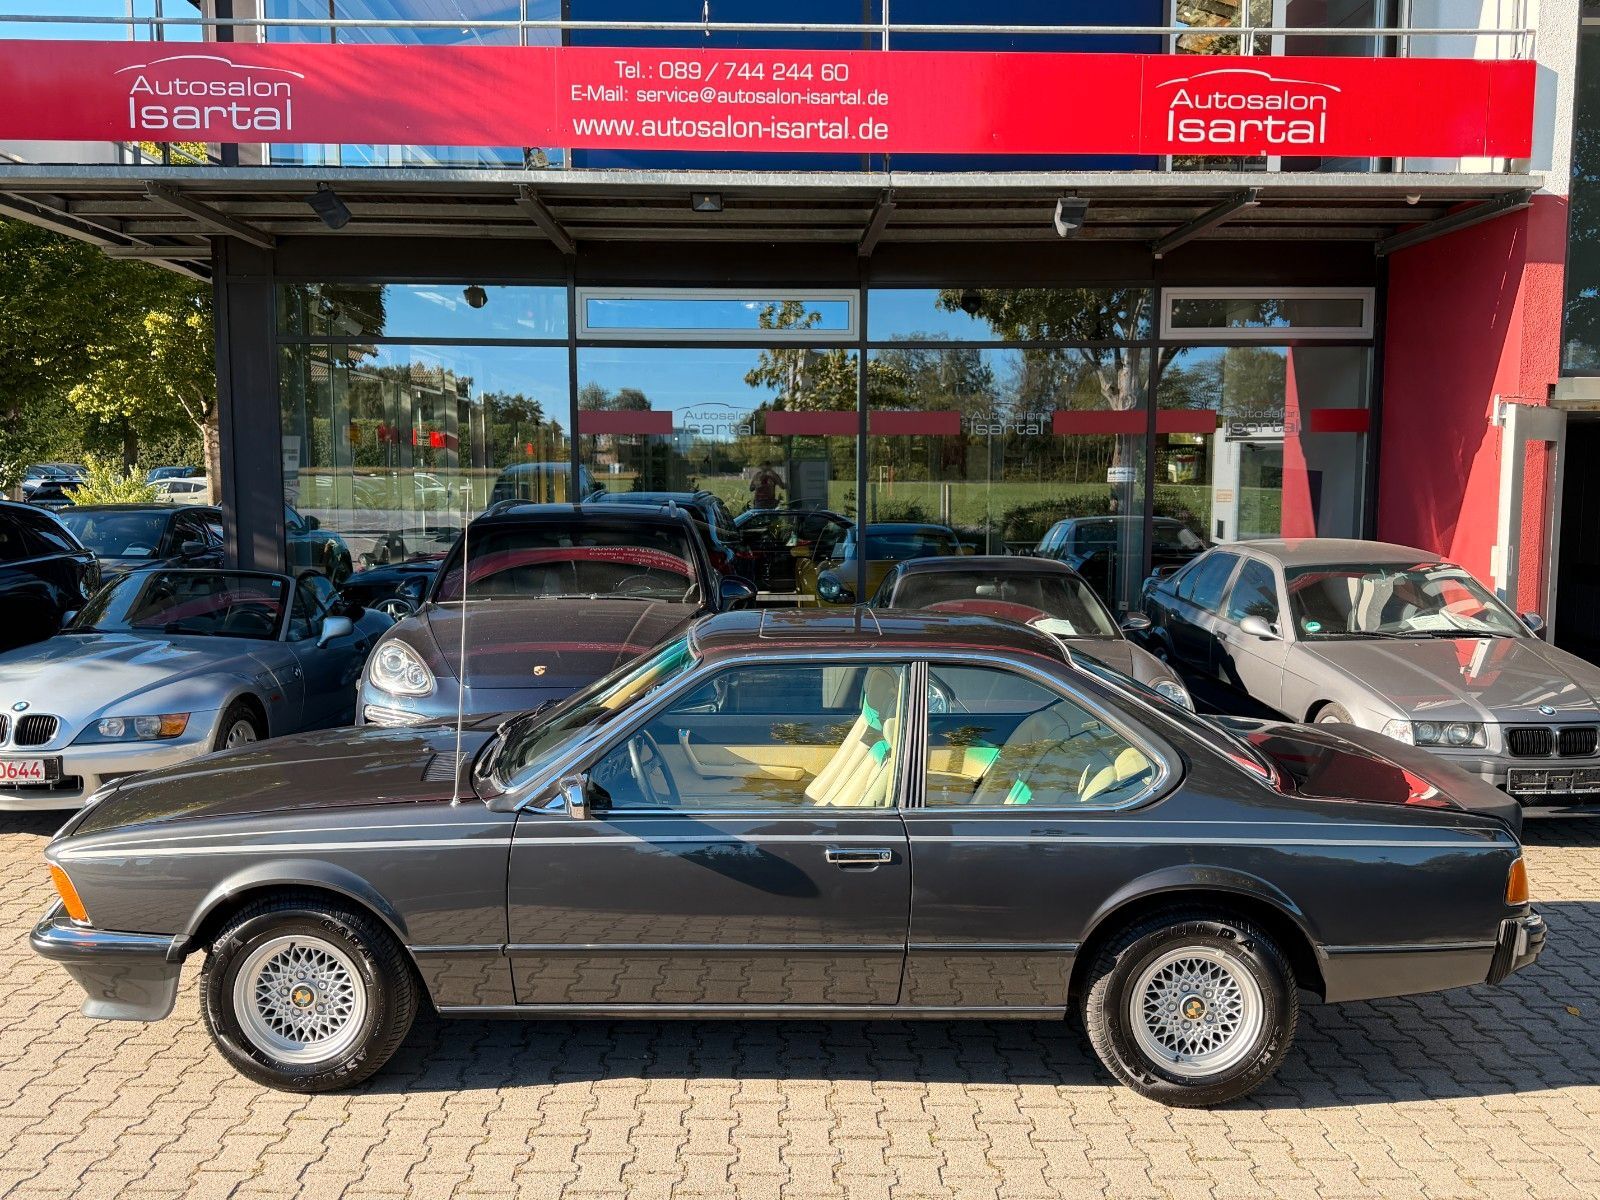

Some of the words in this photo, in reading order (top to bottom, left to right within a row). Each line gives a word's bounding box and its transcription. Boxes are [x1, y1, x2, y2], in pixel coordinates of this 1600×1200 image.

[614, 60, 653, 80] Tel.:
[659, 61, 701, 80] 089
[724, 62, 765, 80] 744
[772, 62, 814, 81] 244
[820, 63, 849, 82] 60
[129, 75, 291, 97] Autosalon
[571, 84, 629, 102] E-Mail:
[636, 86, 889, 106] service@autosalon-isartal.de
[1169, 88, 1327, 111] Autosalon
[129, 96, 292, 131] Isartal
[572, 114, 889, 140] www.autosalon-isartal.de
[1167, 109, 1326, 144] Isartal
[971, 410, 1044, 421] Autoalon
[1225, 419, 1300, 434] Isartal
[683, 420, 756, 435] Isartal
[970, 420, 1044, 435] Isartal
